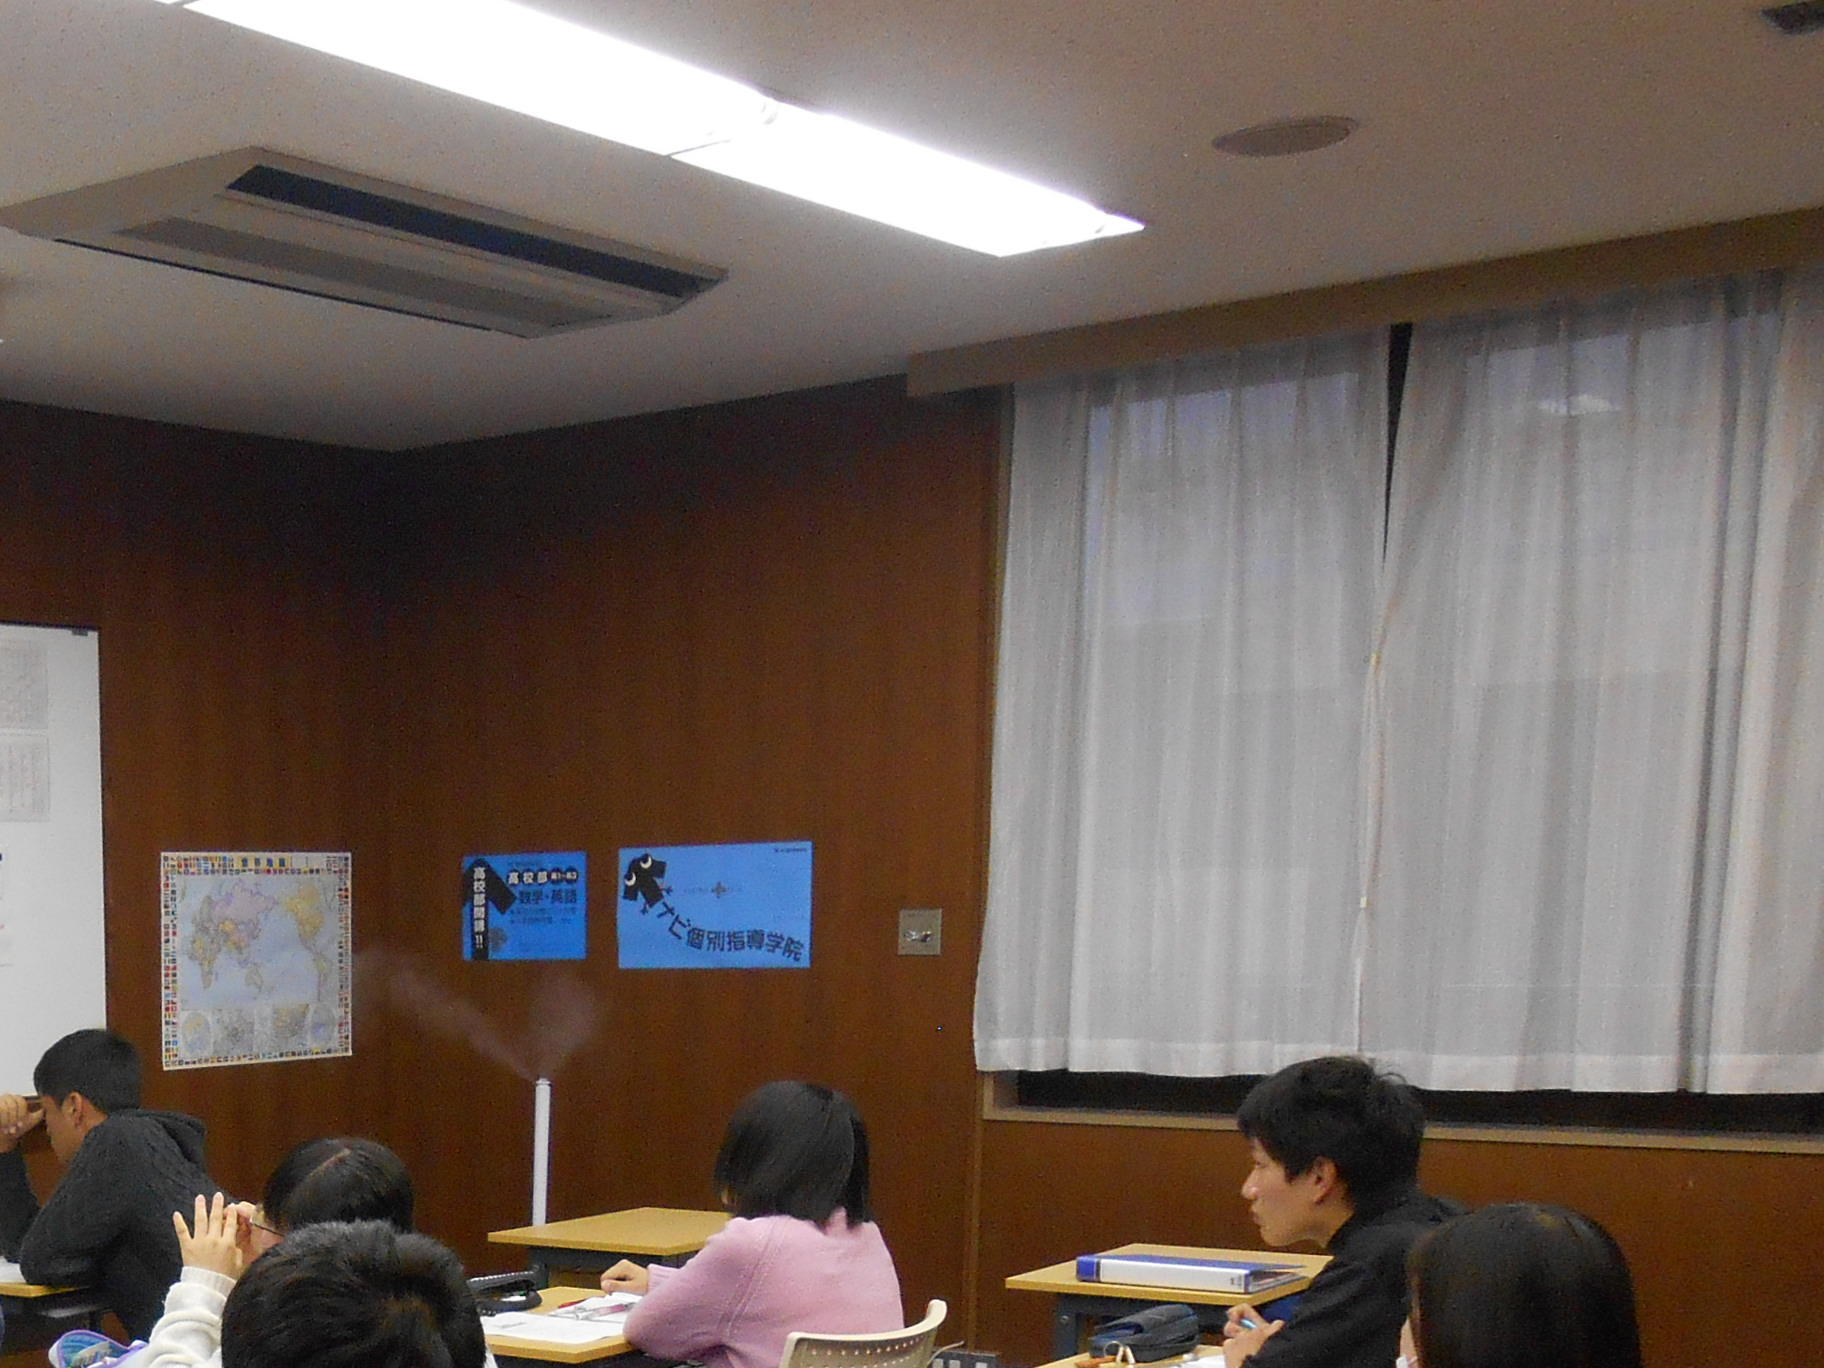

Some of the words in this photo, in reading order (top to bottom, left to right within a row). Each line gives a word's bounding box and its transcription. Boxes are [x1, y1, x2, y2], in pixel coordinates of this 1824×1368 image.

[656, 901, 805, 962] ナビ個別指導学院
